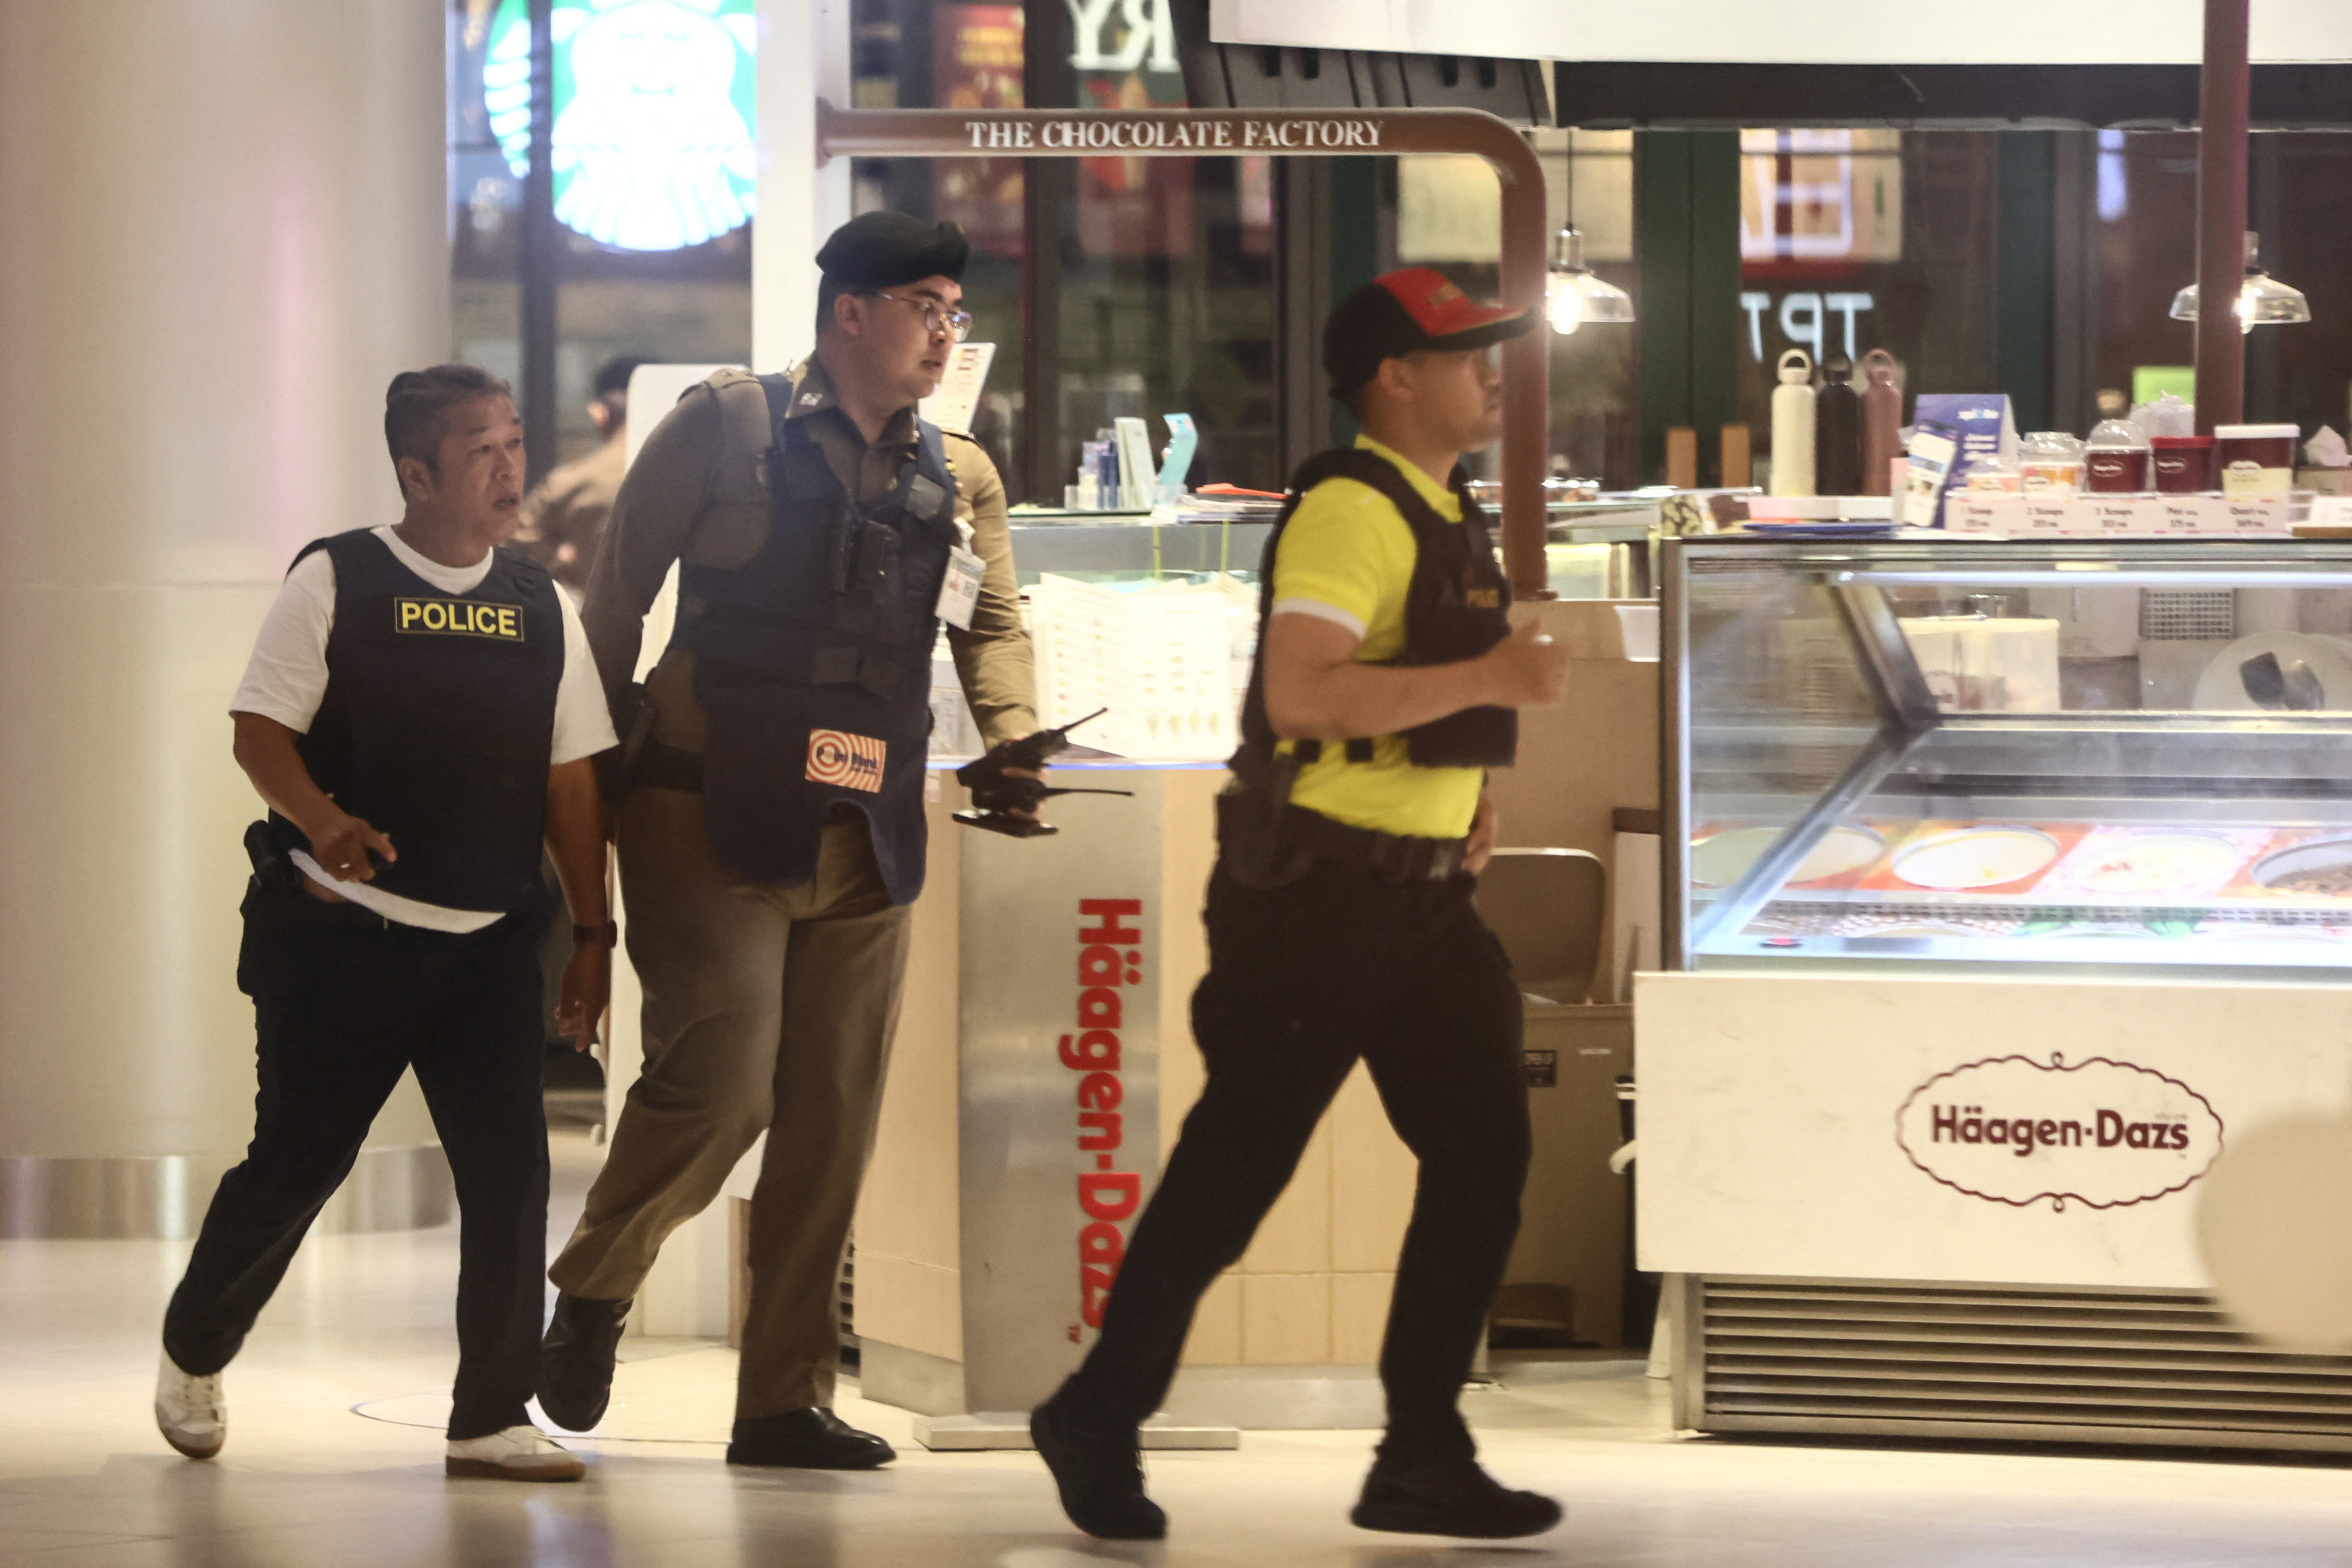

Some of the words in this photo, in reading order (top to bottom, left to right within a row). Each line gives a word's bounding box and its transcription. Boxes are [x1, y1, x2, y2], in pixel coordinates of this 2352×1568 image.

[965, 121, 1035, 148] THE
[1041, 120, 1233, 147] CHOCOLATE
[1243, 120, 1383, 147] FACTORY
[401, 601, 517, 636] POLICE
[1931, 1104, 2190, 1157] Häagen-Dazs
